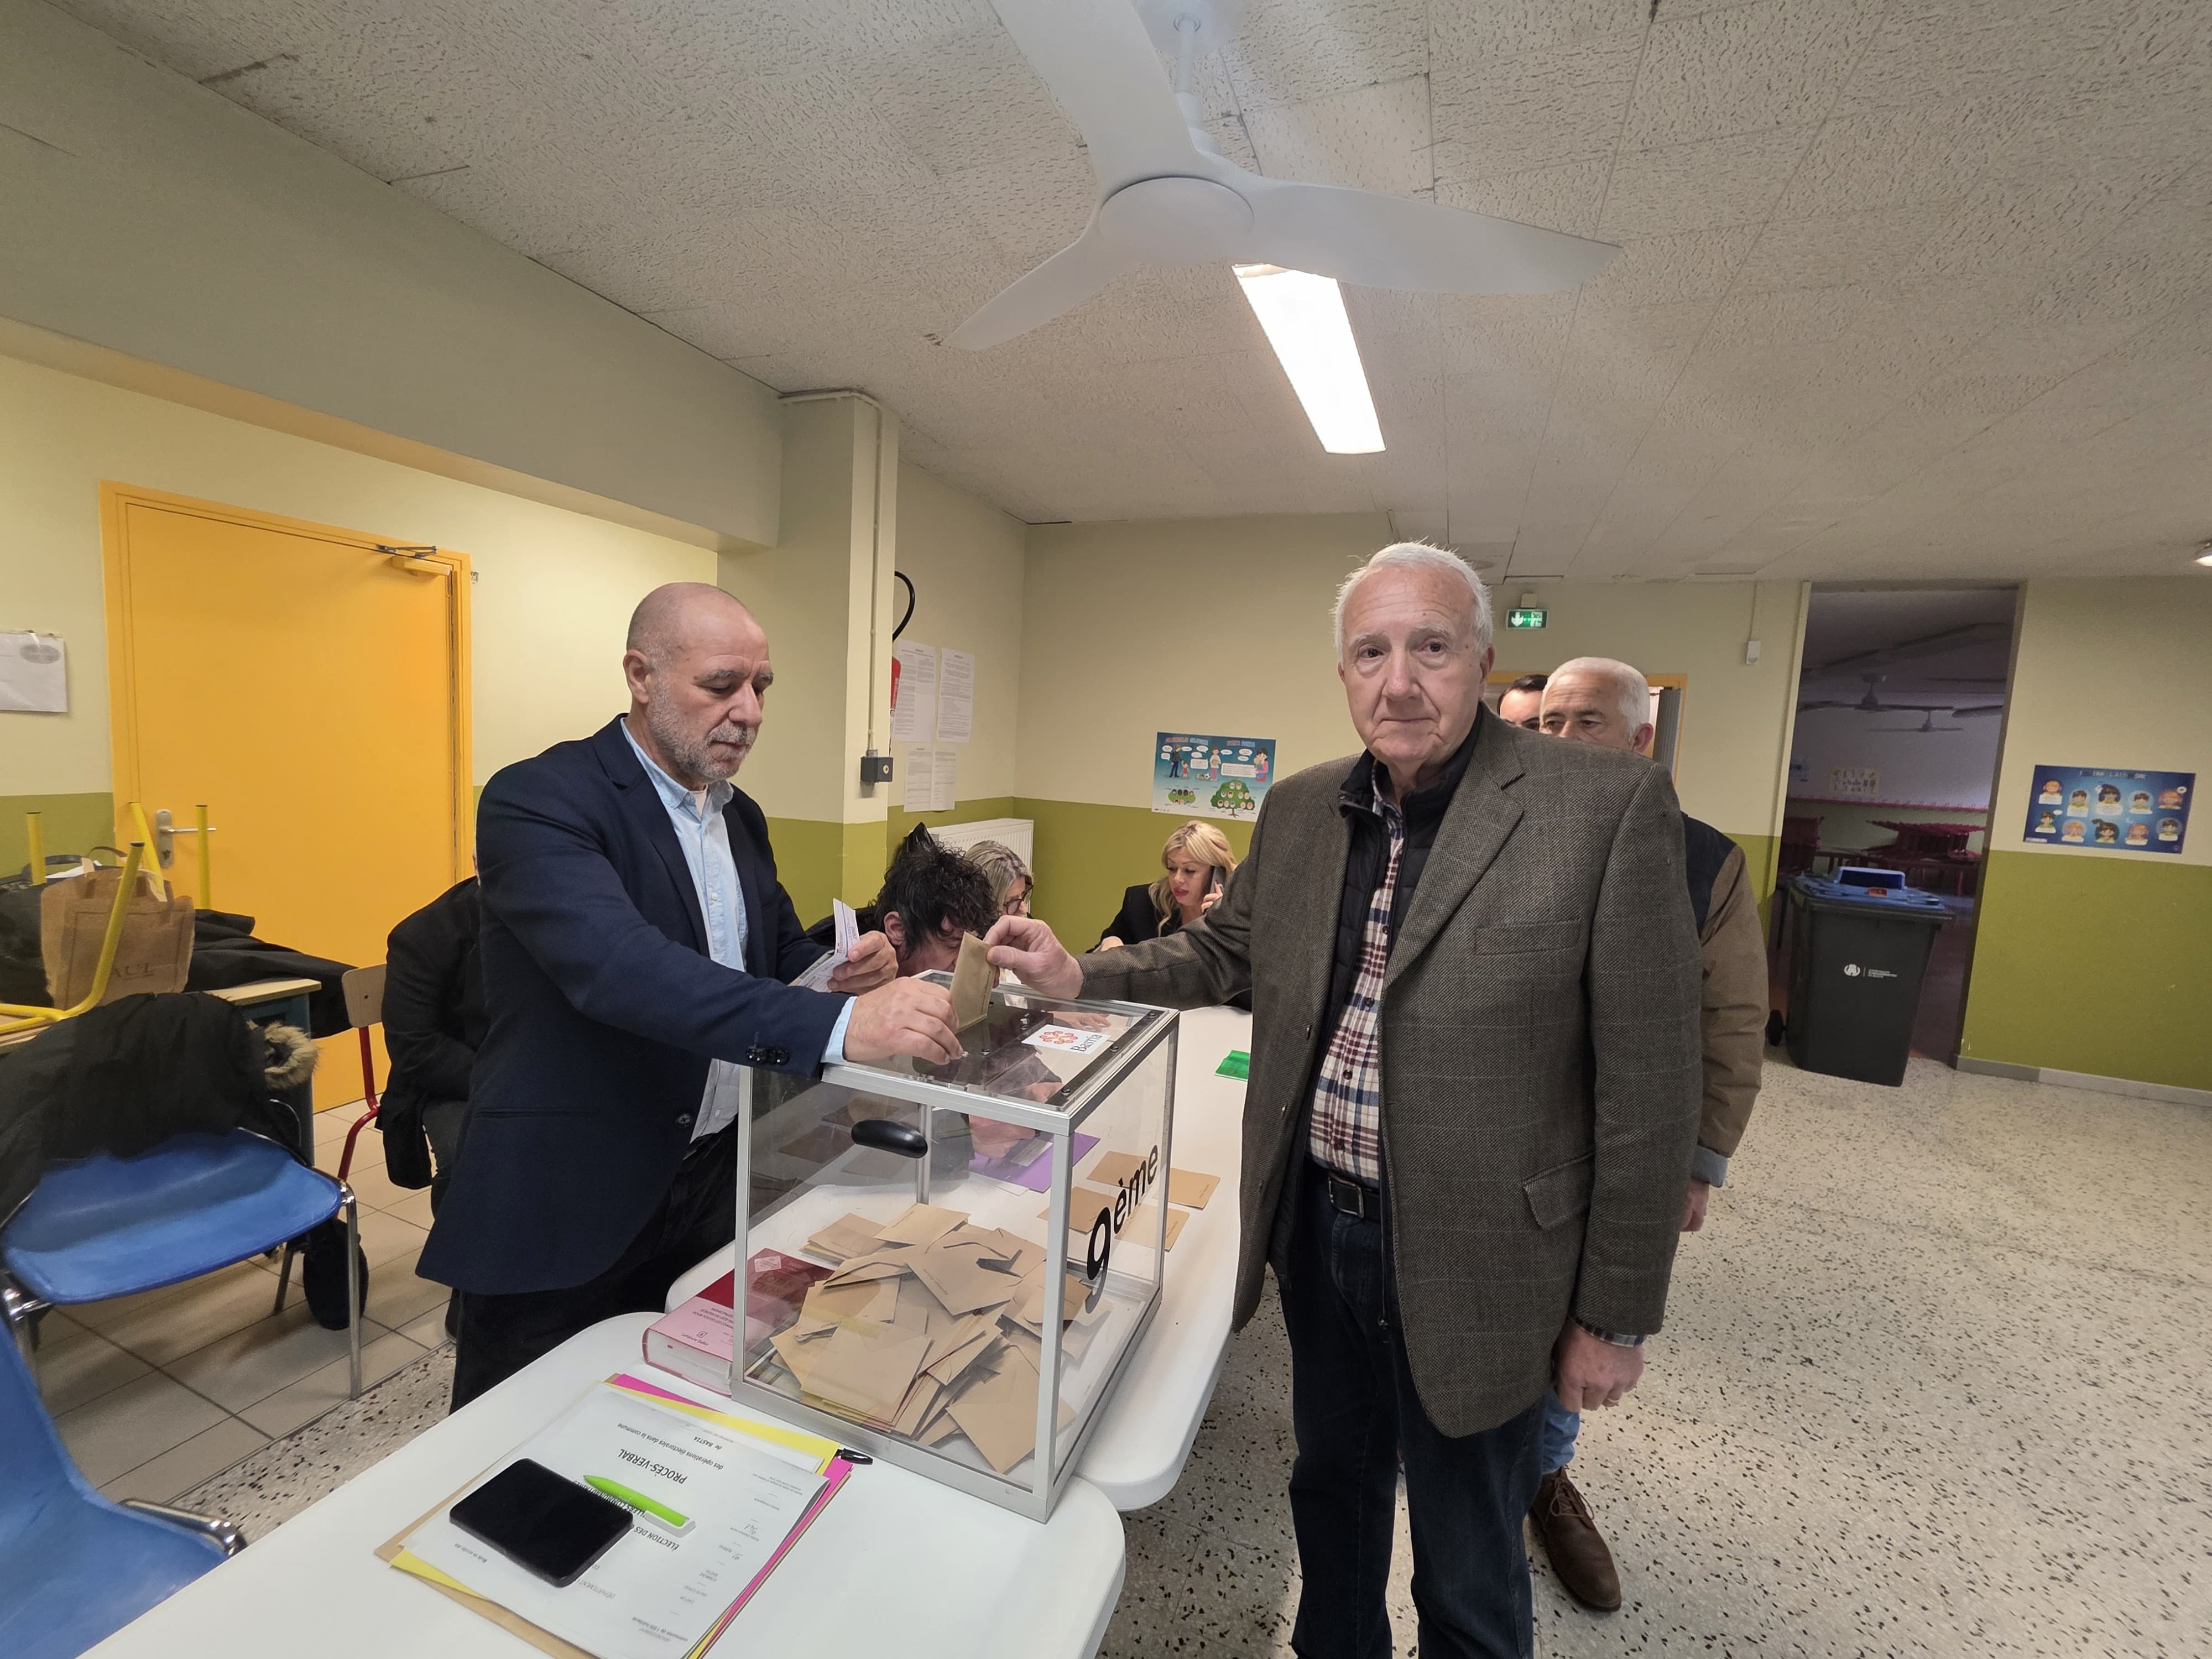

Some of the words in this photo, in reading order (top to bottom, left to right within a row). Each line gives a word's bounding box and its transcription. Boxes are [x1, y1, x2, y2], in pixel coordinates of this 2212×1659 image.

[111, 963, 156, 978] AUL
[1070, 1034, 1103, 1052] Bastia
[1087, 1145, 1158, 1280] 9ème
[617, 1423, 641, 1436] commune
[647, 1434, 659, 1443] dans
[693, 1436, 713, 1447] BASTIA
[659, 1440, 686, 1456] électorales
[685, 1449, 714, 1466] opérations
[618, 1448, 687, 1484] PROCÈS-VERBAL
[634, 1526, 649, 1537] DES
[646, 1532, 680, 1552] ÉLECTION
